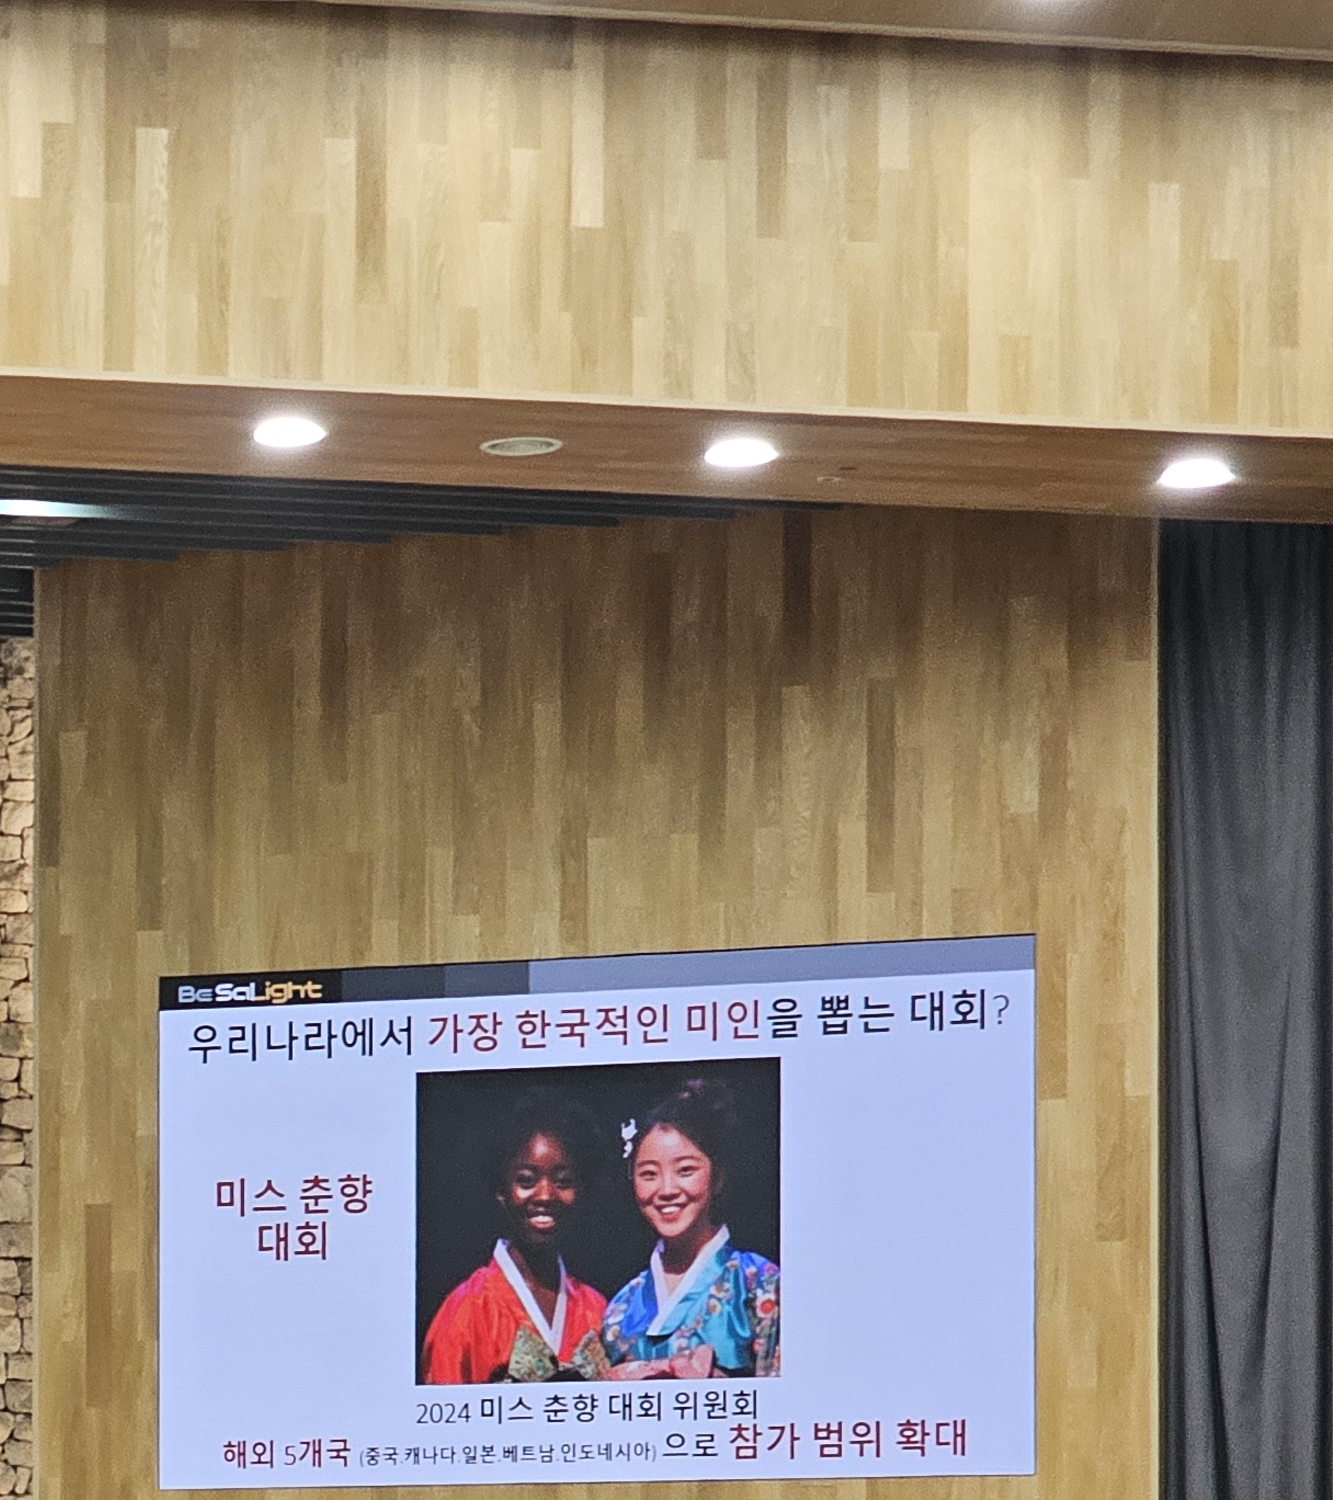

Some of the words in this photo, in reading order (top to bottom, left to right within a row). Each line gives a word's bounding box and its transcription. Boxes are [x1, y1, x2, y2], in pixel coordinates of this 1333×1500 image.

[188, 1015, 413, 1064] 우리나라에서
[429, 1011, 503, 1054] 가장
[515, 1004, 670, 1050] 한국적인
[686, 998, 803, 1041] 미인을
[816, 994, 895, 1035] 뽑는
[909, 988, 1011, 1031] 대회?
[216, 1178, 287, 1217] 미스
[299, 1174, 373, 1214] 춘향
[258, 1221, 327, 1262] 대회
[415, 1402, 472, 1424] 2024
[480, 1396, 534, 1424] 미스
[542, 1394, 600, 1423] 춘향
[608, 1392, 663, 1421] 대회
[672, 1389, 759, 1421] 위원회
[223, 1440, 275, 1469] 해외
[284, 1438, 352, 1468] 5개국
[662, 1432, 720, 1459] 으로
[729, 1423, 801, 1461] 참가
[813, 1419, 883, 1459] 범위
[895, 1418, 968, 1457] 확대
